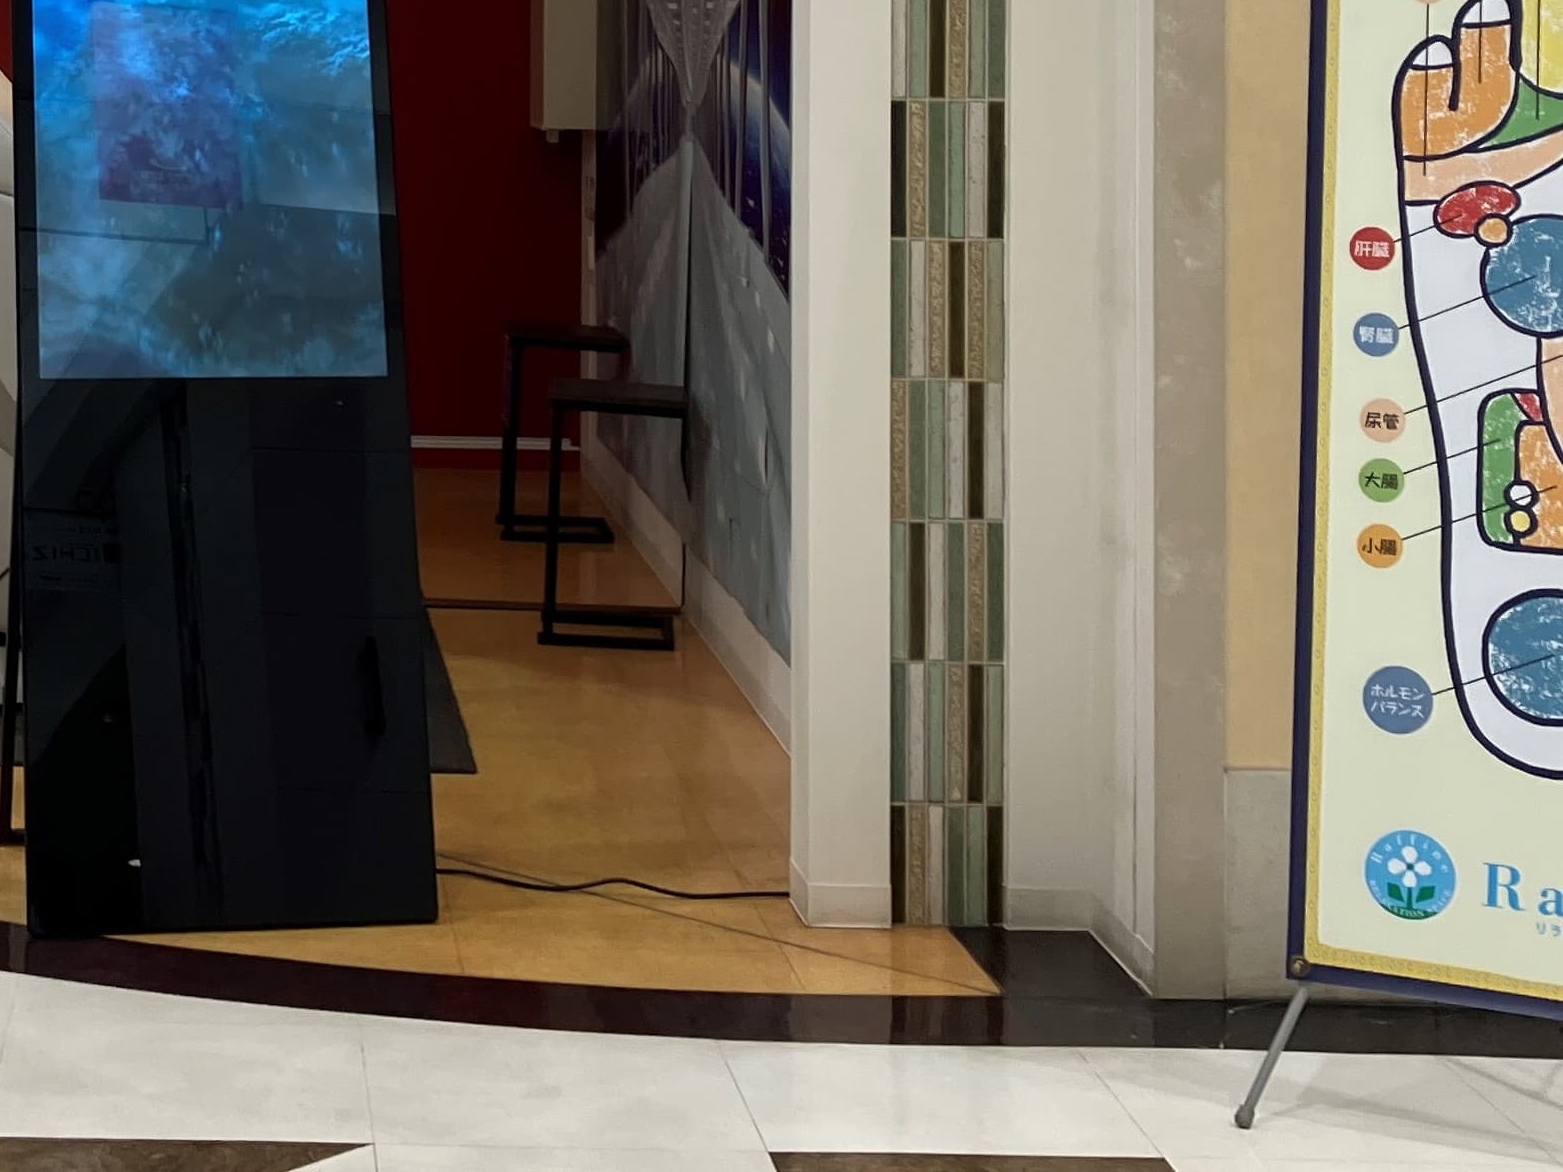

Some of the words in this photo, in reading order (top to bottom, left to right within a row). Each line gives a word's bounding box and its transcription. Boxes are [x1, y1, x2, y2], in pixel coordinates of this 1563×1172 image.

[1354, 240, 1389, 258] 肝臓
[1365, 411, 1399, 430] 尿管
[1365, 471, 1399, 490] 大腸
[1362, 537, 1397, 556] 小腸
[1370, 684, 1425, 700] ホルモン
